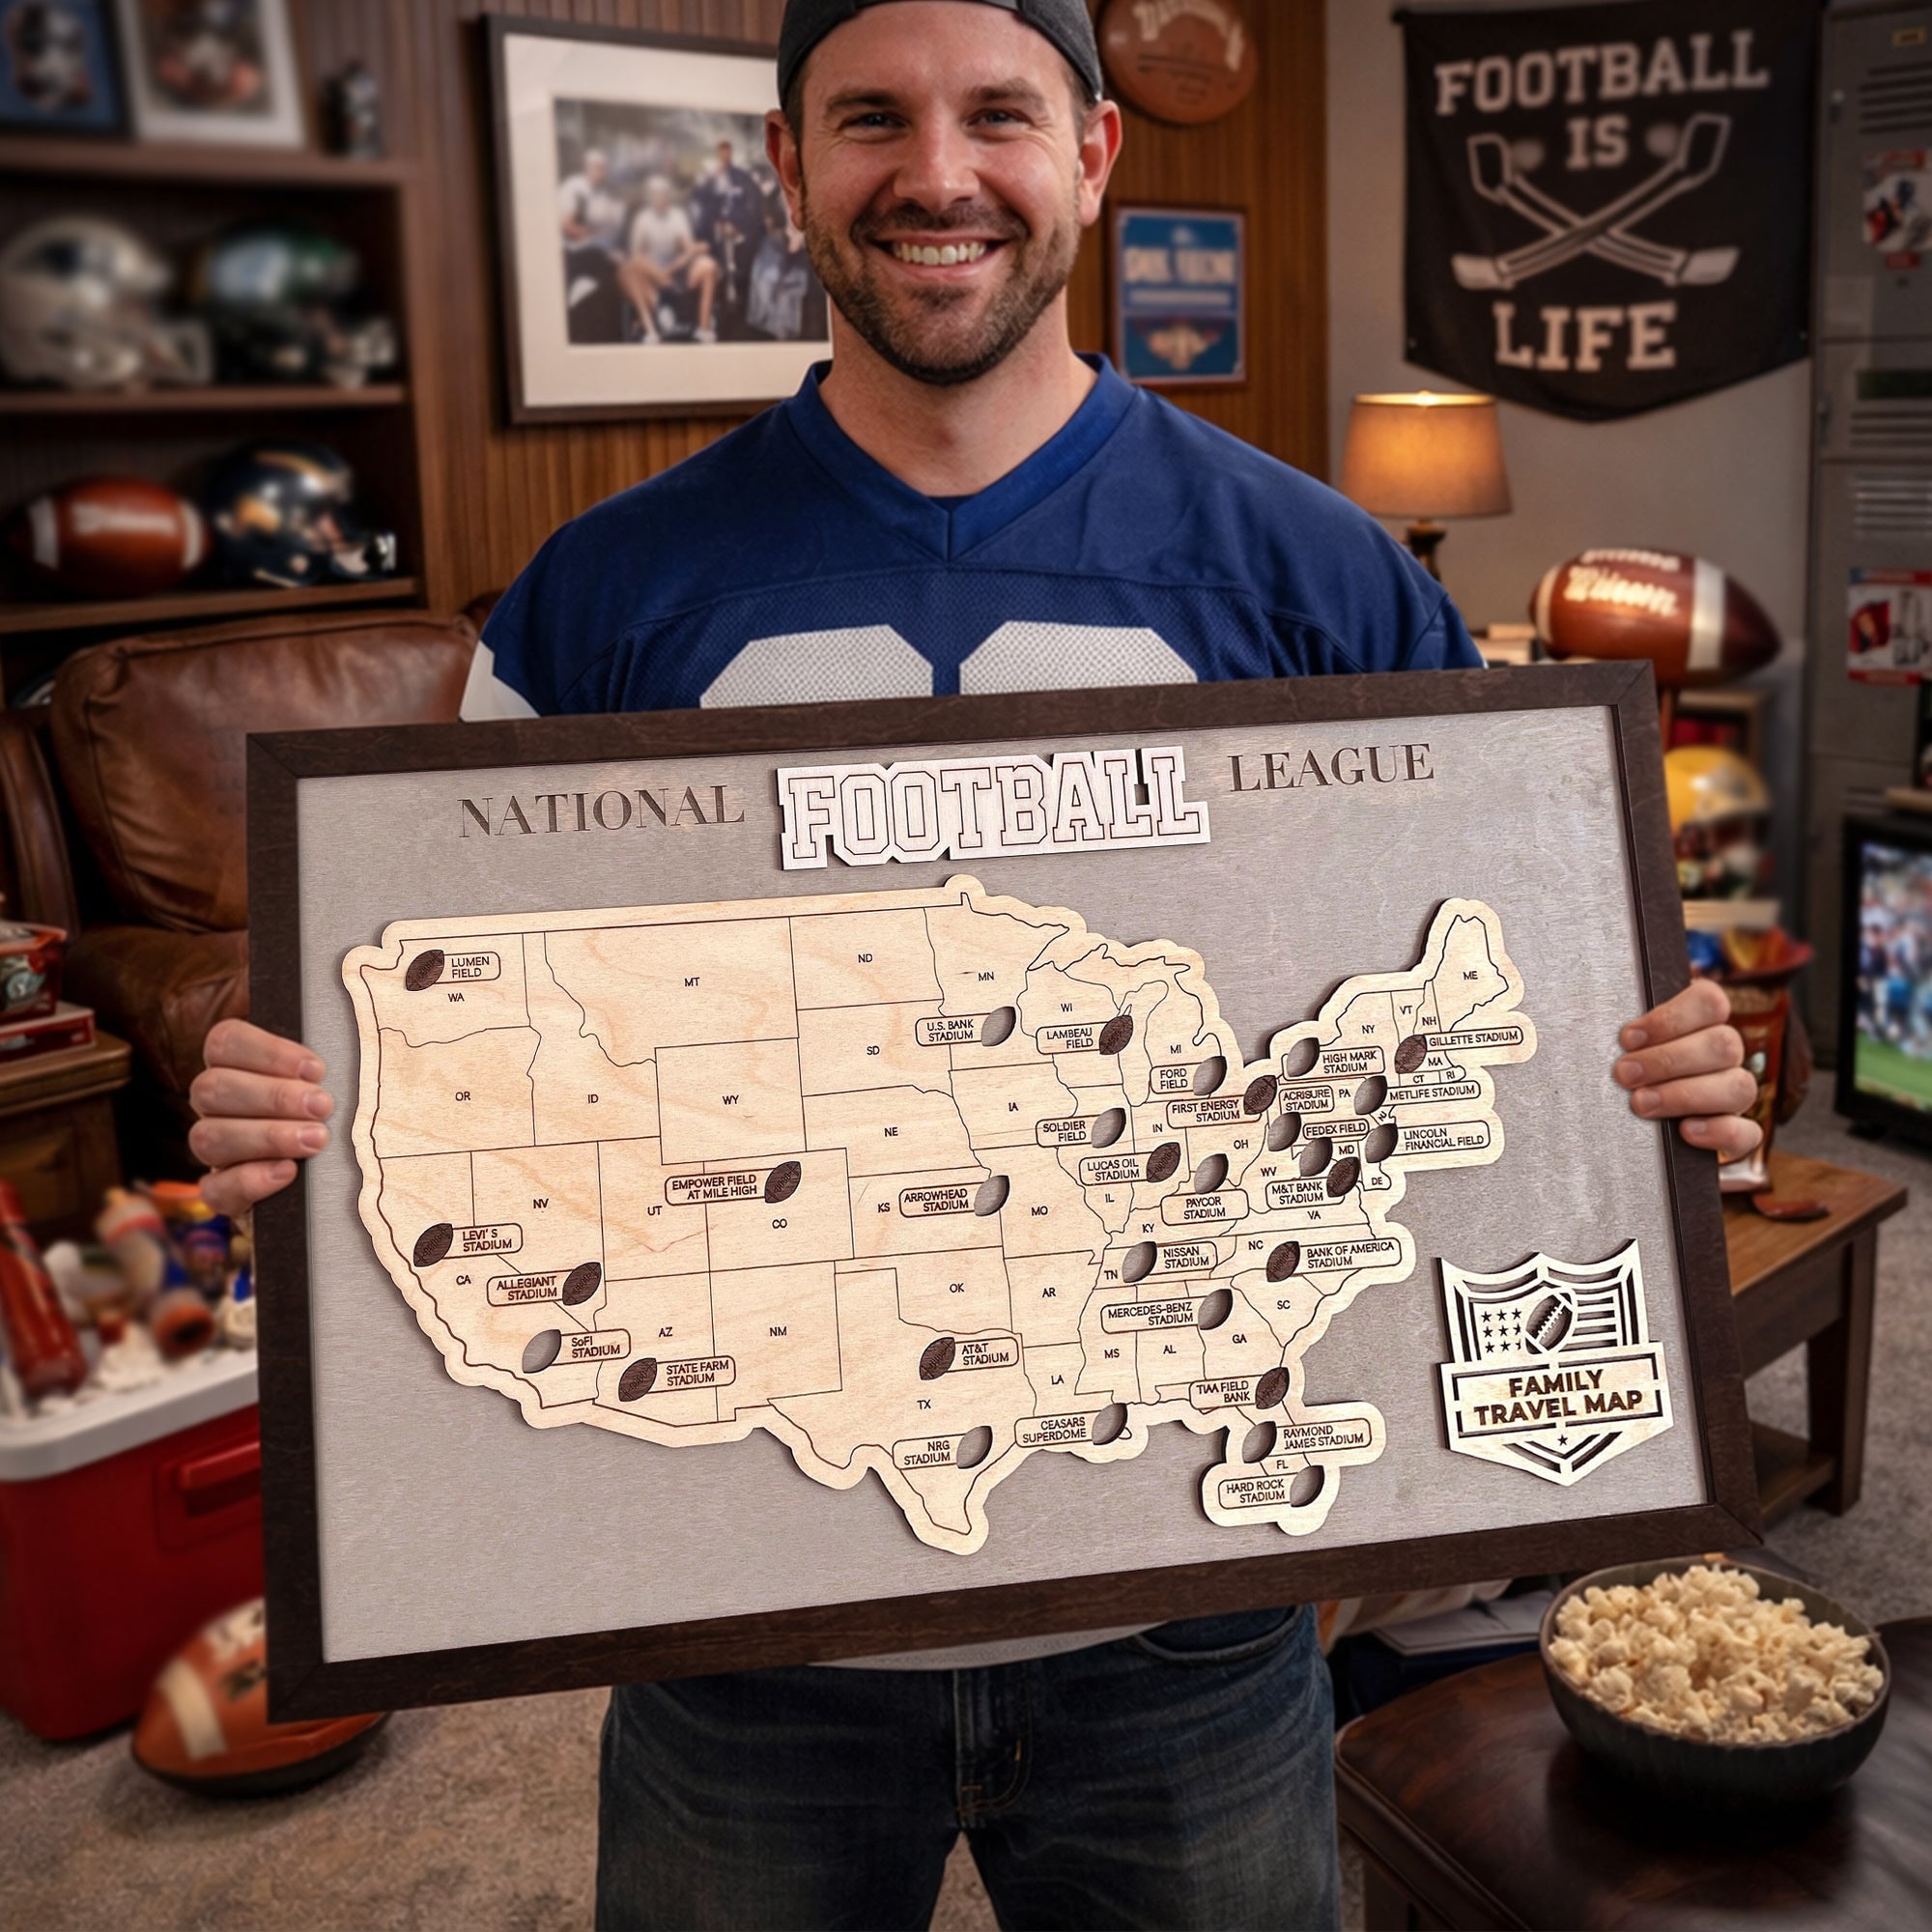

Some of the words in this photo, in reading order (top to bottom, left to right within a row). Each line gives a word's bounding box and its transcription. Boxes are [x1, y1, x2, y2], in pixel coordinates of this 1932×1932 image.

[1435, 31, 1769, 114] FOOTBALL
[1566, 117, 1628, 170] IS
[1494, 302, 1676, 372] LIFE
[458, 783, 745, 839] NATIONAL
[790, 753, 1201, 863] FOOTBALL
[1230, 742, 1435, 794] LEAGUE
[451, 956, 490, 967] LUMEN
[858, 952, 873, 963] ND
[451, 968, 482, 979] FIELD
[978, 972, 995, 981] MN
[1463, 971, 1478, 980] ME
[684, 977, 700, 987] MT
[447, 993, 465, 1002] WA
[1060, 1003, 1072, 1012] WI
[1400, 1006, 1413, 1014] VT
[927, 1021, 945, 1032] U.S.
[948, 1019, 974, 1029] BANK
[1422, 1016, 1436, 1026] NH
[928, 1028, 974, 1041] STADIUM
[1046, 1027, 1093, 1040] LAMBEAU
[1362, 1025, 1376, 1034] NY
[1066, 1037, 1094, 1049] FIELD
[1429, 1035, 1474, 1046] GILLETTE
[1476, 1031, 1519, 1042] STADIUM
[867, 1045, 880, 1056] SD
[1170, 1045, 1181, 1054] MI
[1322, 1053, 1348, 1064] HIGH
[1350, 1051, 1377, 1062] MARK
[1428, 1057, 1443, 1066] MA
[1160, 1068, 1187, 1079] FORD
[1323, 1063, 1368, 1074] STADIUM
[1413, 1075, 1425, 1084] CT
[1446, 1070, 1456, 1080] RI
[1160, 1079, 1188, 1090] FIELD
[455, 1092, 470, 1101] OR
[1283, 1089, 1330, 1101] ACRISURE
[1339, 1089, 1351, 1098] PA
[1389, 1089, 1430, 1101] METLIFE
[1432, 1085, 1475, 1097] STADIUM
[587, 1094, 599, 1104] ID
[723, 1095, 739, 1105] WY
[1009, 1102, 1018, 1112] IA
[1172, 1103, 1198, 1114] FIRST
[1200, 1100, 1239, 1112] ENERGY
[1285, 1099, 1329, 1112] STADIUM
[1196, 1111, 1240, 1122] STADIUM
[884, 1126, 898, 1137] NE
[1043, 1121, 1086, 1133] SOLDIER
[1152, 1123, 1163, 1133] IN
[1306, 1124, 1338, 1137] FEDEX
[1339, 1122, 1367, 1134] FIELD
[1058, 1130, 1087, 1142] FIELD
[1404, 1128, 1447, 1140] LINCOLN
[1234, 1140, 1249, 1150] OH
[1405, 1138, 1456, 1151] FINANCIAL
[1458, 1135, 1484, 1147] FIELD
[1339, 1145, 1355, 1155] MD
[1087, 1160, 1120, 1172] LUCAS
[1122, 1158, 1139, 1168] OIL
[1094, 1169, 1140, 1181] STADIUM
[1261, 1167, 1277, 1177] WV
[672, 1177, 724, 1190] EMPOWER
[726, 1174, 756, 1185] FIELD
[1372, 1177, 1382, 1185] DE
[687, 1188, 700, 1198] AT
[702, 1186, 729, 1198] MILE
[731, 1185, 757, 1196] HIGH
[1271, 1183, 1295, 1195] M&T
[1296, 1181, 1322, 1192] BANK
[904, 1188, 967, 1203] ARROWHEAD
[1105, 1194, 1115, 1203] IL
[1279, 1192, 1323, 1205] STADIUM
[532, 1199, 549, 1208] NV
[877, 1203, 891, 1212] KS
[923, 1198, 969, 1211] STADIUM
[1186, 1196, 1222, 1208] PAYCOR
[647, 1207, 663, 1216] UT
[1031, 1206, 1048, 1216] MO
[1183, 1207, 1226, 1219] STADIUM
[1308, 1210, 1321, 1220] VA
[772, 1219, 787, 1229] CO
[1142, 1224, 1154, 1234] KY
[463, 1239, 512, 1252] STADIUM
[1248, 1240, 1264, 1250] NC
[1307, 1247, 1332, 1259] BANK
[1335, 1246, 1348, 1256] OF
[1350, 1241, 1395, 1255] AMERICA
[1163, 1245, 1200, 1259] NISSAN
[1164, 1255, 1209, 1268] STADIUM
[1307, 1256, 1353, 1268] STADIUM
[1104, 1270, 1118, 1279] TN
[456, 1275, 471, 1286] CA
[497, 1276, 557, 1291] ALLEGIANT
[950, 1283, 964, 1293] OK
[1042, 1288, 1056, 1298] AR
[508, 1288, 557, 1301] STADIUM
[1108, 1301, 1192, 1319] MERCEDES-BENZ
[1277, 1300, 1291, 1310] SC
[1148, 1313, 1193, 1325] STADIUM
[659, 1327, 673, 1337] AZ
[770, 1326, 787, 1337] NM
[1233, 1334, 1247, 1344] GA
[572, 1344, 620, 1358] STADIUM
[962, 1343, 989, 1354] AT&T
[1164, 1345, 1176, 1354] AL
[963, 1352, 1009, 1365] STADIUM
[1104, 1350, 1120, 1359] MS
[666, 1361, 698, 1374] STATE
[699, 1359, 729, 1372] FARM
[667, 1372, 715, 1385] STADIUM
[1051, 1376, 1065, 1385] LA
[1509, 1369, 1603, 1398] FAMILY
[1222, 1380, 1249, 1392] FIELD
[1224, 1391, 1250, 1402] BANK
[918, 1401, 931, 1409] TX
[1473, 1398, 1577, 1425] TRAVEL
[1584, 1390, 1642, 1414] MAP
[1040, 1418, 1086, 1430] CEASARS
[1022, 1429, 1087, 1443] SUPERDOME
[1283, 1425, 1333, 1439] RAYMOND
[927, 1441, 951, 1452] NRG
[1284, 1437, 1316, 1449] JAMES
[1318, 1433, 1364, 1446] STADIUM
[904, 1452, 951, 1465] STADIUM
[1277, 1461, 1289, 1469] FL
[1227, 1482, 1254, 1493] HARD
[1256, 1479, 1284, 1491] ROCK
[1239, 1491, 1285, 1502] STADIUM
